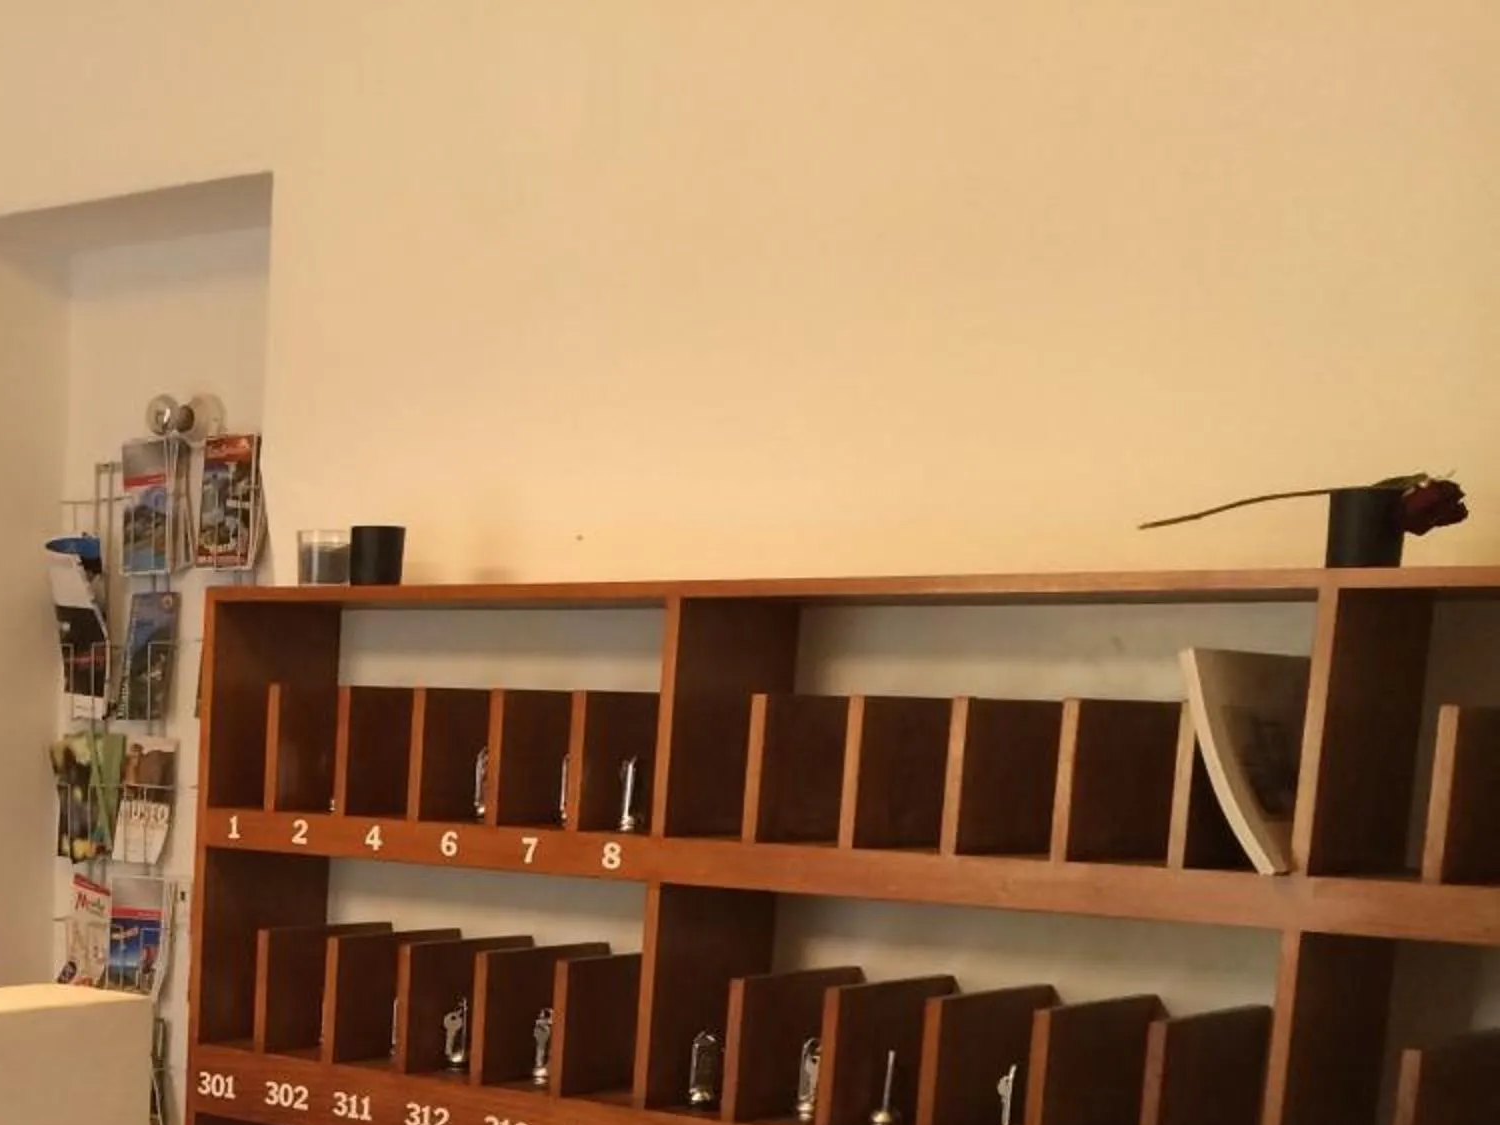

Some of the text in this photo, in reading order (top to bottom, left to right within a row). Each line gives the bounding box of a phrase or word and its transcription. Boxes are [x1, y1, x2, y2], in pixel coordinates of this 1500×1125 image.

[227, 815, 241, 839] 1
[291, 819, 309, 845] 2
[365, 825, 383, 851] 4
[440, 831, 458, 857] 6
[521, 836, 539, 864] 7
[601, 841, 621, 870] 8
[197, 1071, 236, 1099] 301
[264, 1081, 309, 1111] 302
[332, 1091, 372, 1121] 311
